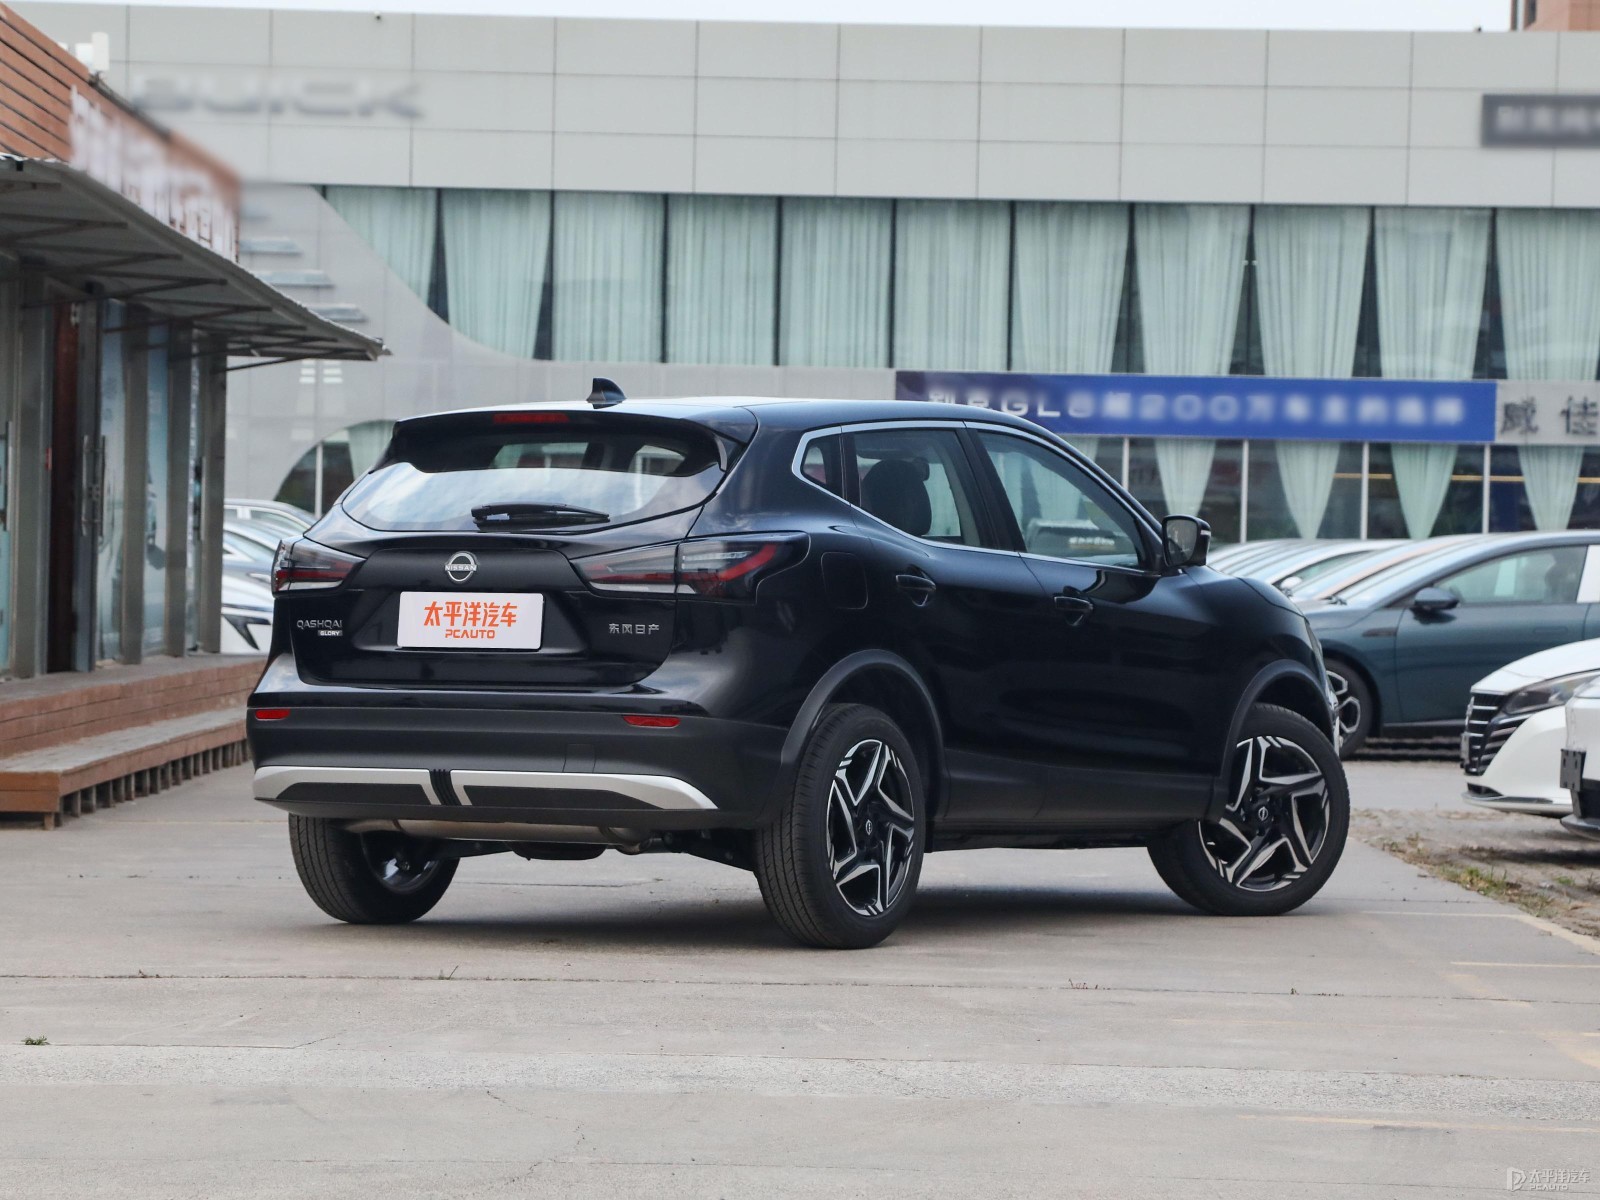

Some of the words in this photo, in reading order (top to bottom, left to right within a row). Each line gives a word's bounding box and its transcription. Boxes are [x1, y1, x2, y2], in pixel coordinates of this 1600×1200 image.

[424, 601, 518, 628] 太平洋汽车
[296, 619, 343, 630] QASHQAI
[608, 623, 660, 635] 东风日产
[445, 629, 496, 639] PCAUTO
